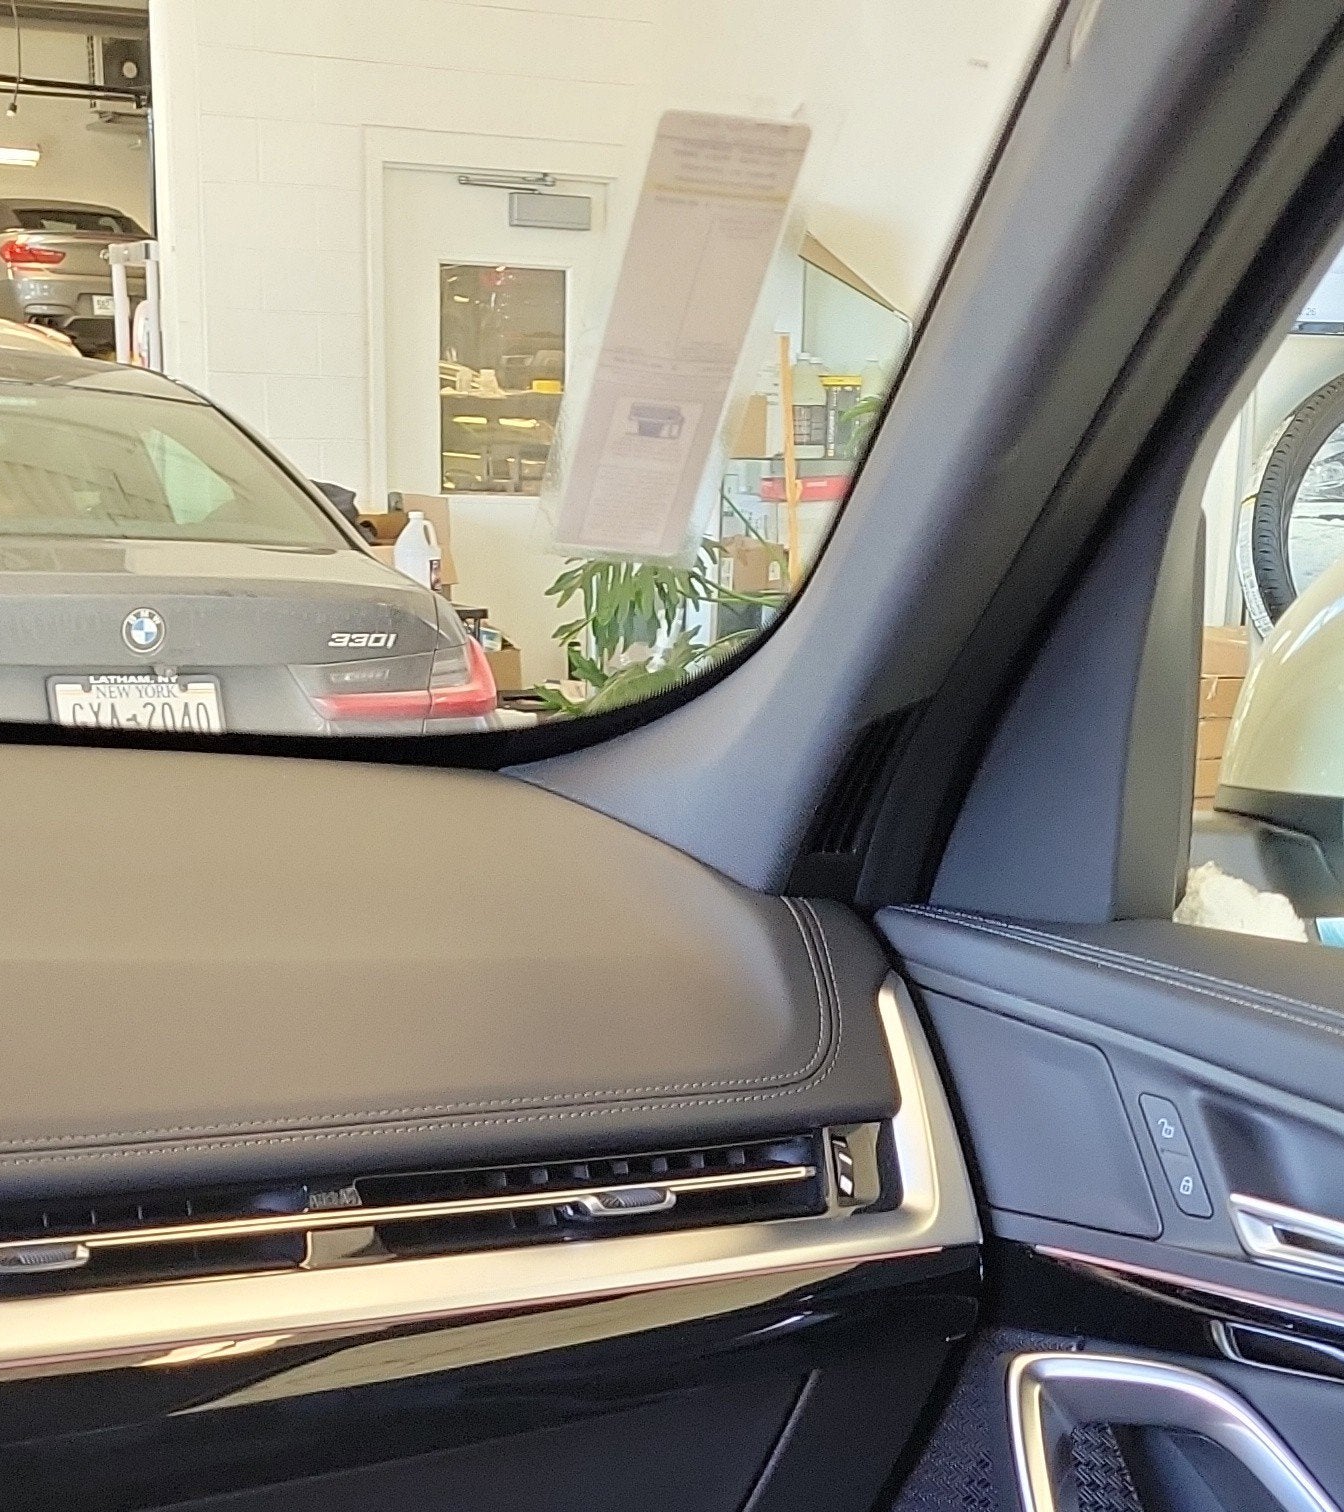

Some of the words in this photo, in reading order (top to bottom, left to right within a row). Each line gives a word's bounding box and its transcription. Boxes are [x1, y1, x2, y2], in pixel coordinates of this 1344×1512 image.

[157, 674, 179, 684] NY
[96, 685, 134, 699] NEW
[136, 684, 178, 699] YORK
